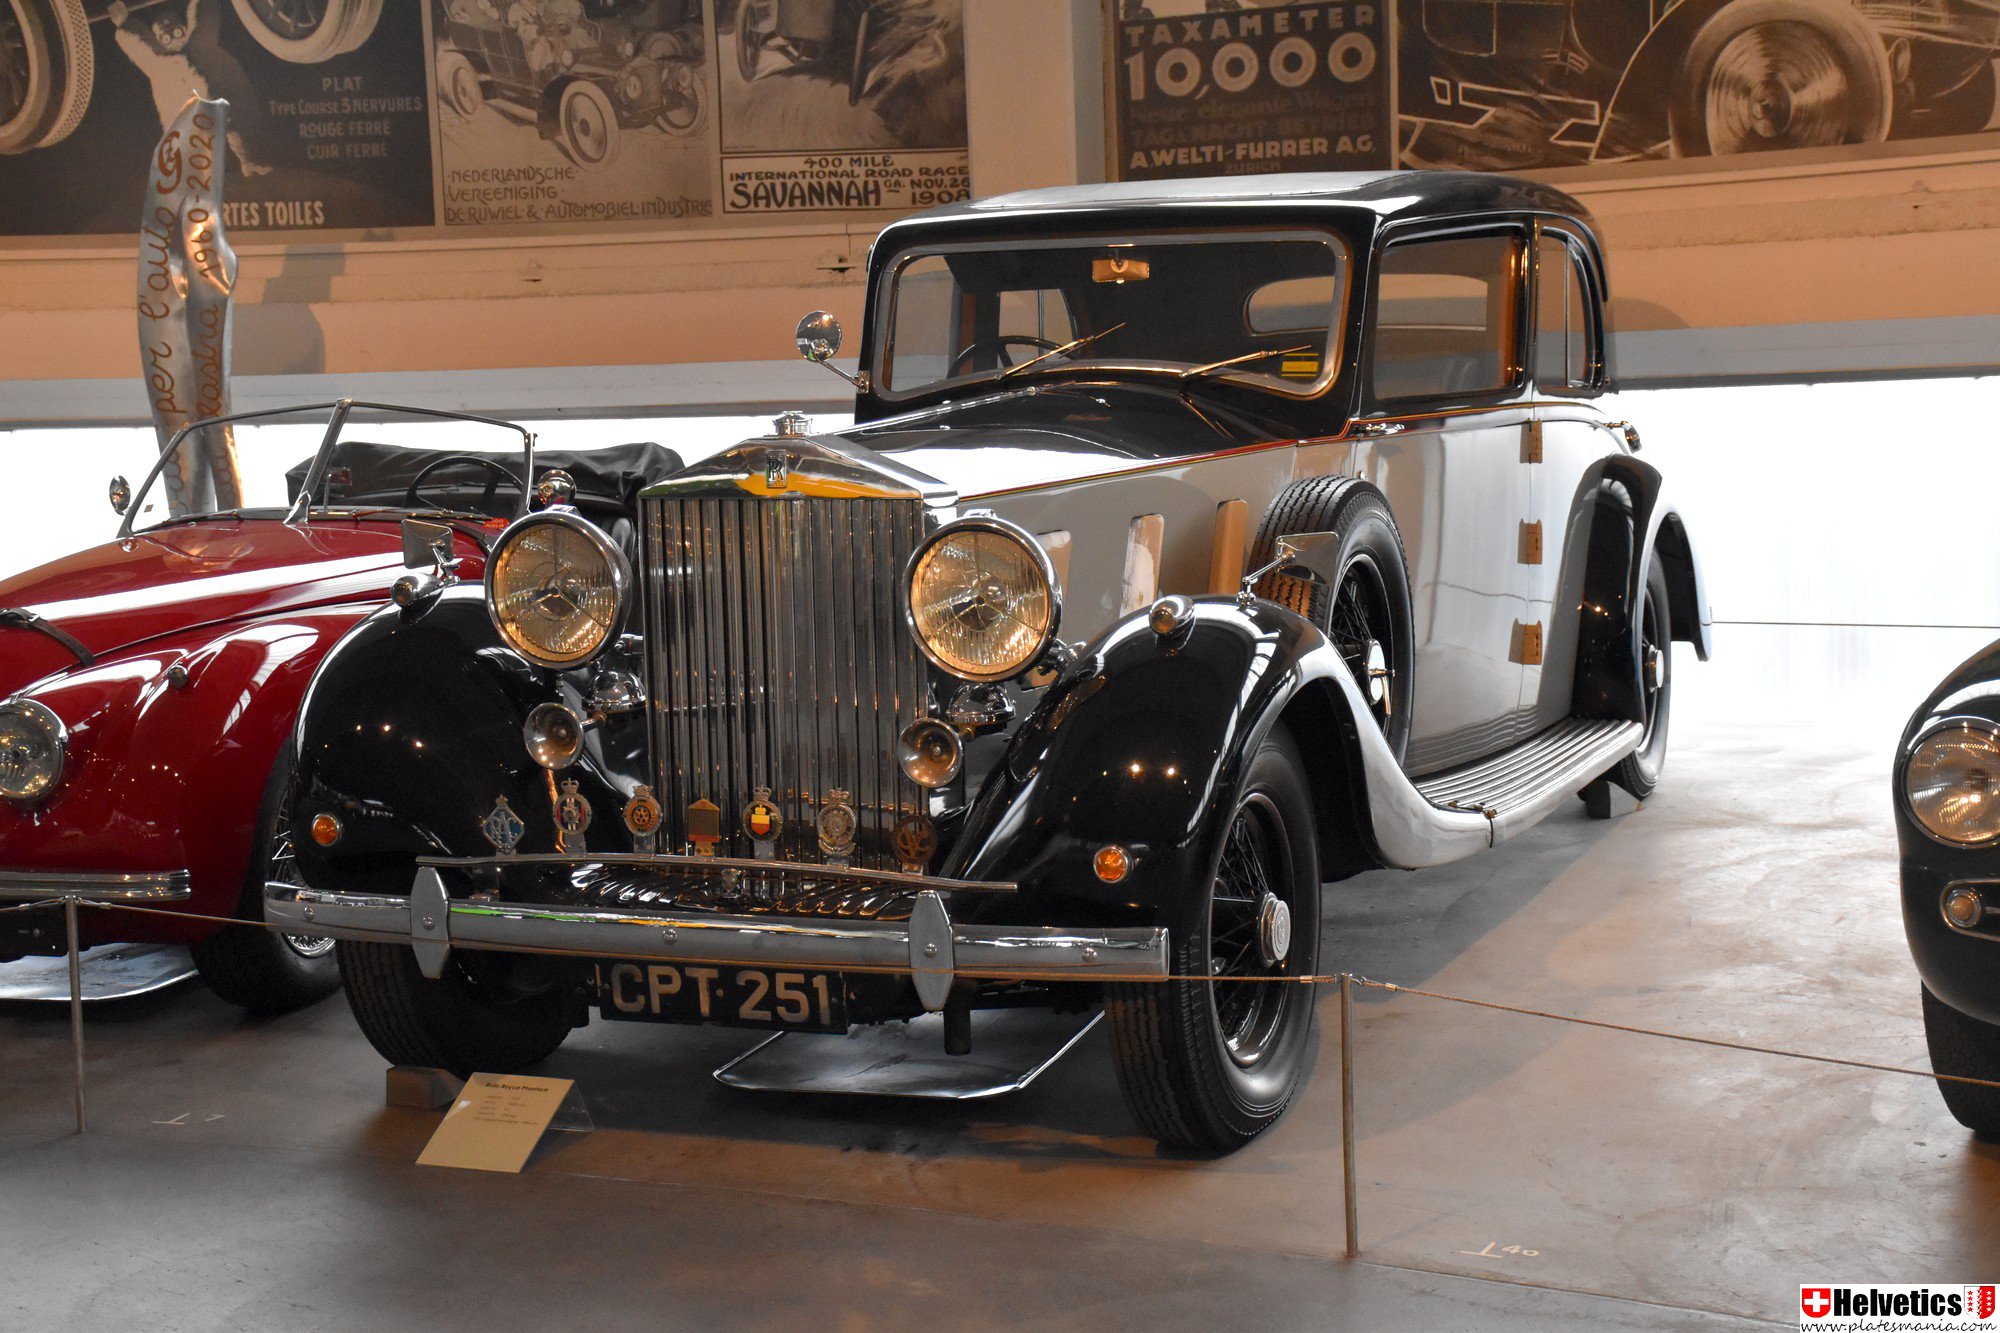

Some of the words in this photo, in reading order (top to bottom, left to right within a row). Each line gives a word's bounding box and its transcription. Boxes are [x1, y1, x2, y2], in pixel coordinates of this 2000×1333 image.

[1124, 4, 1375, 48] TAXAMETER
[1123, 32, 1377, 101] 10,000
[322, 76, 363, 92] PLAT
[352, 95, 423, 112] NERVURES
[298, 121, 344, 138] ROUGE
[307, 143, 341, 160] CUIR
[804, 156, 844, 170] 400
[849, 155, 894, 169] MILE
[729, 168, 860, 183] INTERNATIONAL
[864, 167, 914, 179] ROAD
[919, 166, 969, 177] RACE
[447, 185, 558, 205] VEREENIGING
[729, 180, 881, 210] SAVANNAH
[911, 189, 971, 205] 1908
[264, 200, 325, 226] TOILES
[447, 207, 466, 223] DE
[611, 963, 719, 1017] CPT
[736, 970, 832, 1025] 251
